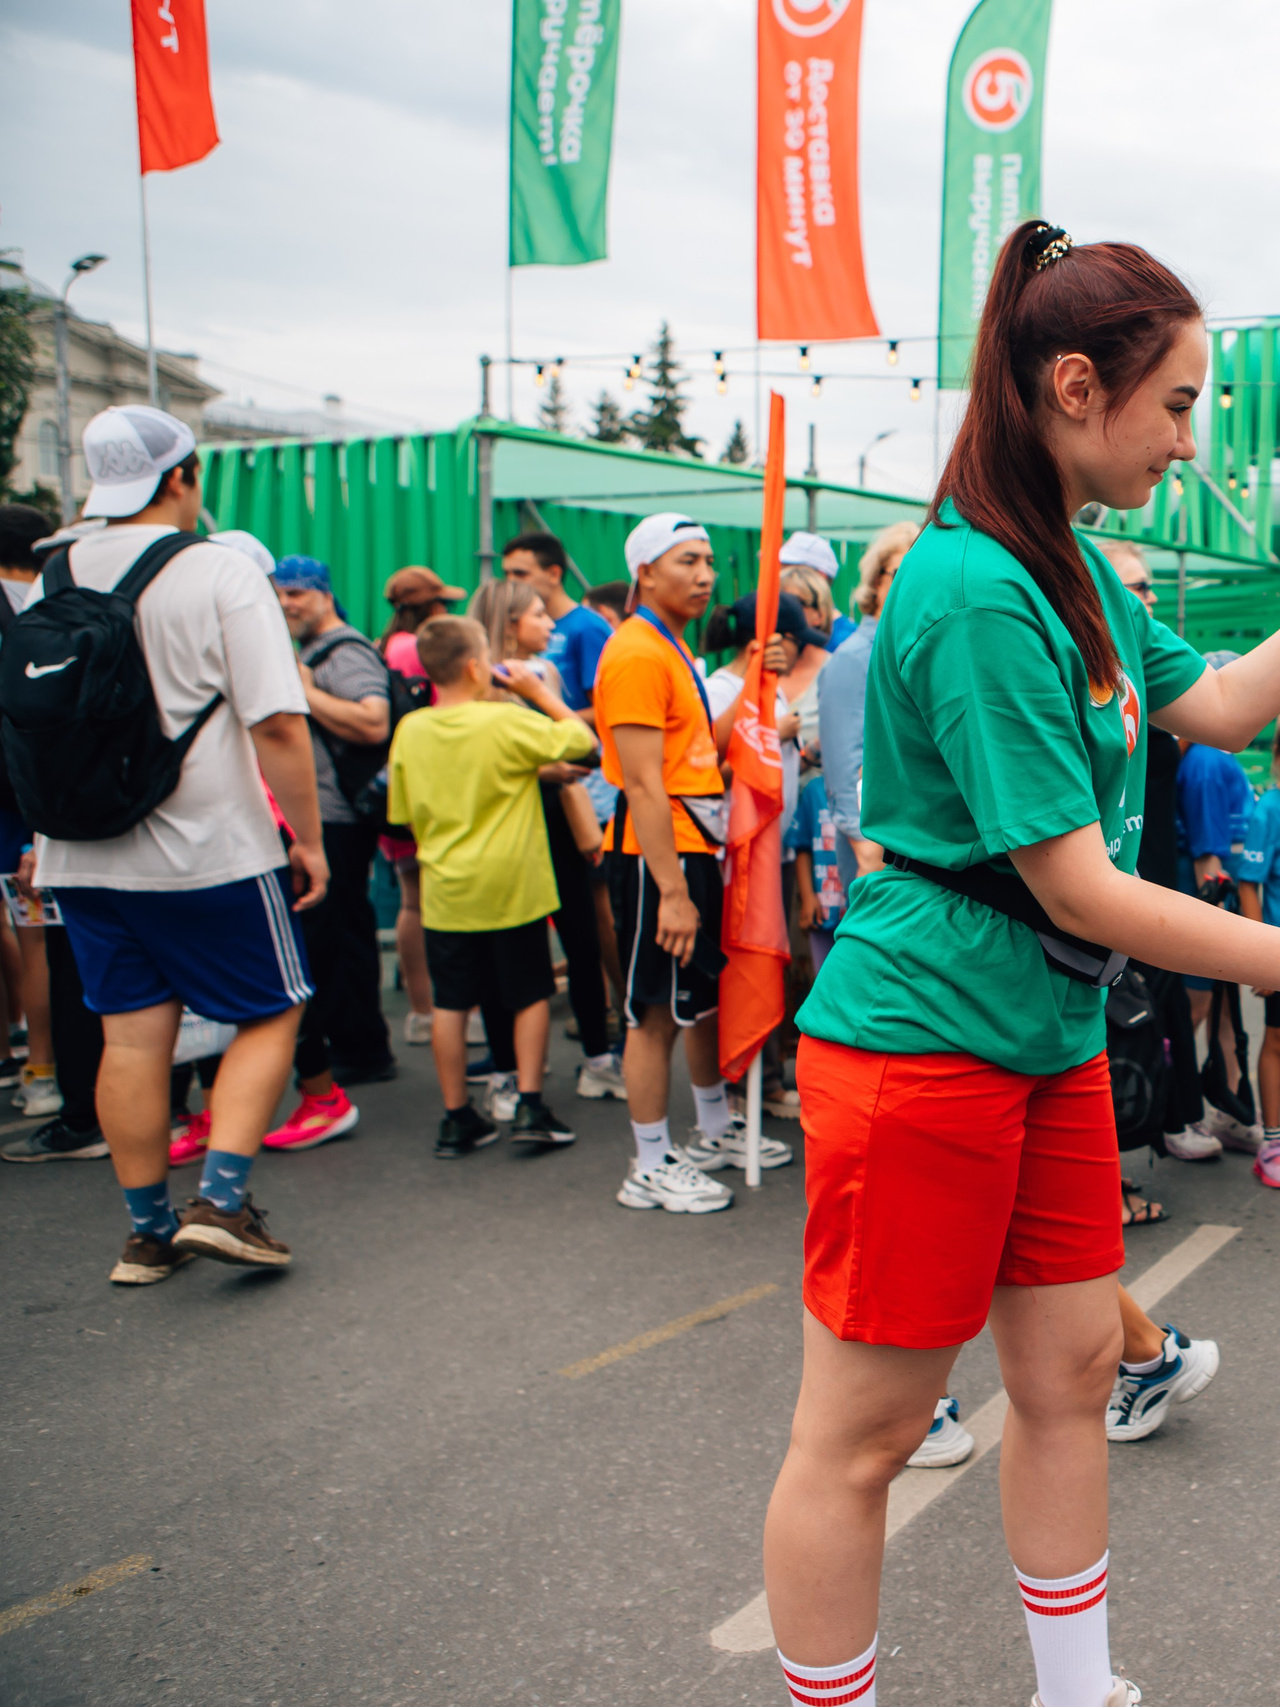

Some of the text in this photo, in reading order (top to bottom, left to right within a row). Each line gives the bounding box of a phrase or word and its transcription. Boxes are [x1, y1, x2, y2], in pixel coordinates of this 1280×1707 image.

[783, 61, 813, 269] от 30 минут
[806, 57, 836, 227] Доставка
